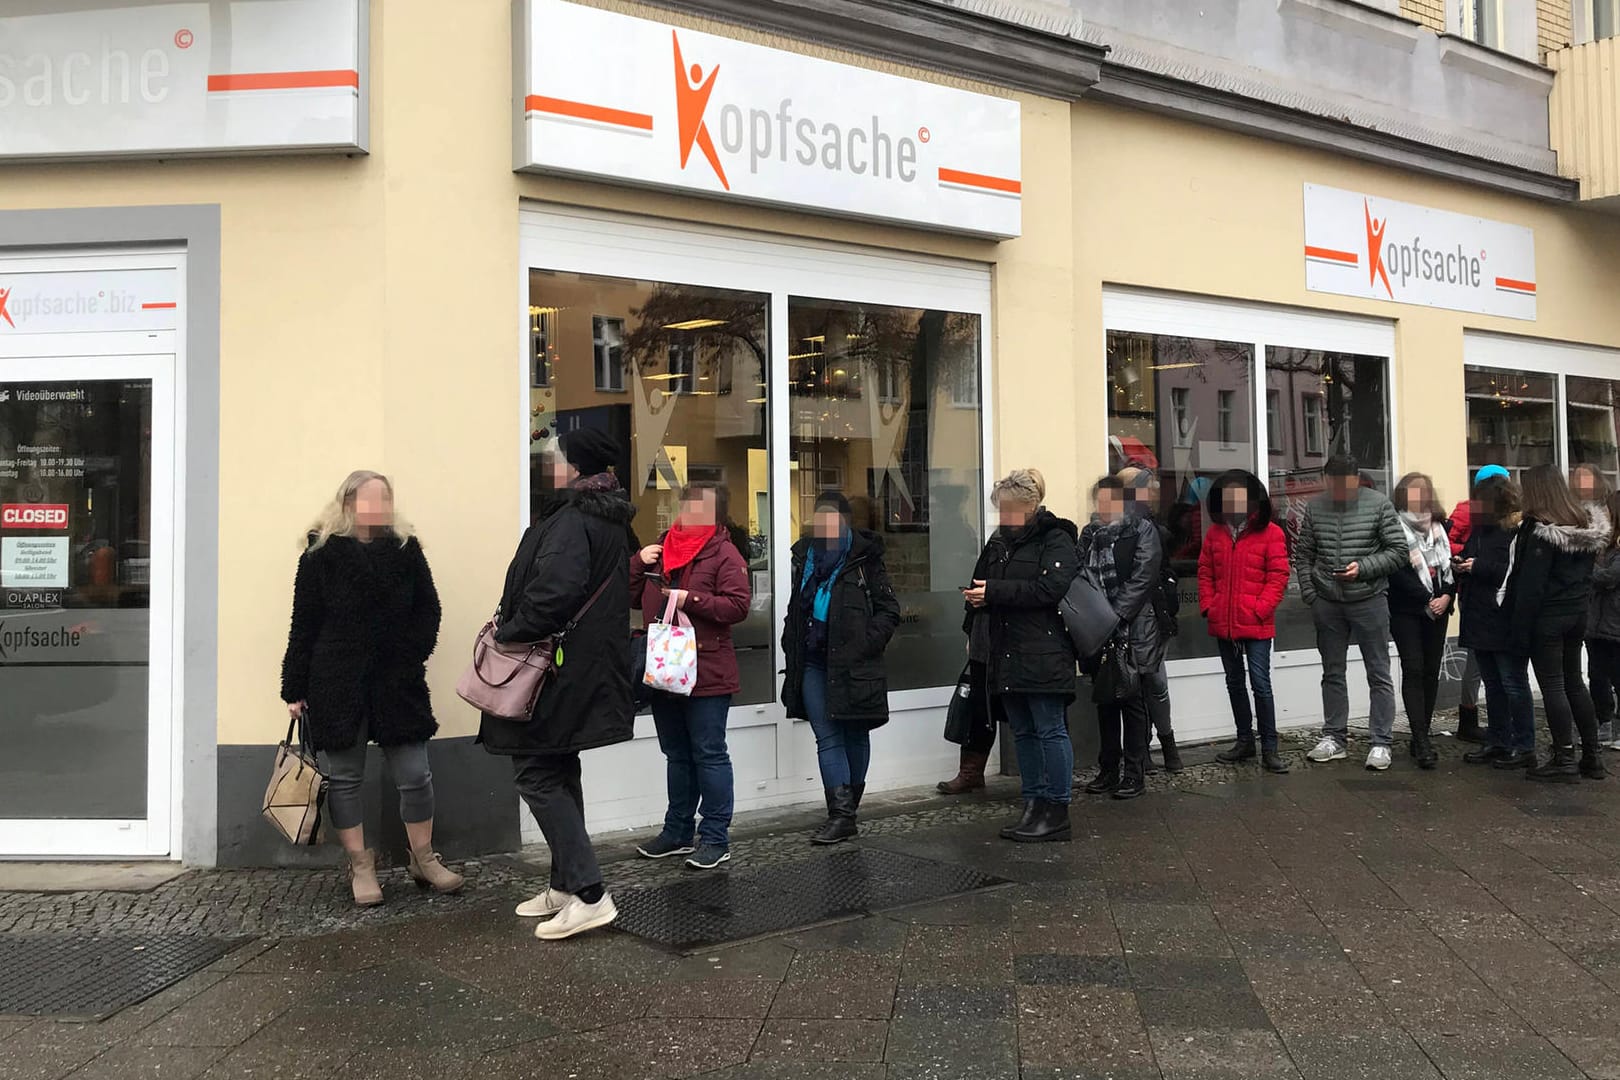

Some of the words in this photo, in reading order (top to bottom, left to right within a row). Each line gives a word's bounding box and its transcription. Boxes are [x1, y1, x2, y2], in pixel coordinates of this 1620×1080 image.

[16, 389, 85, 401] Videoüberwacht
[74, 458, 85, 466] Uhr
[74, 469, 85, 477] Uhr
[4, 509, 66, 523] CLOSED
[8, 592, 58, 603] OLAPLEX
